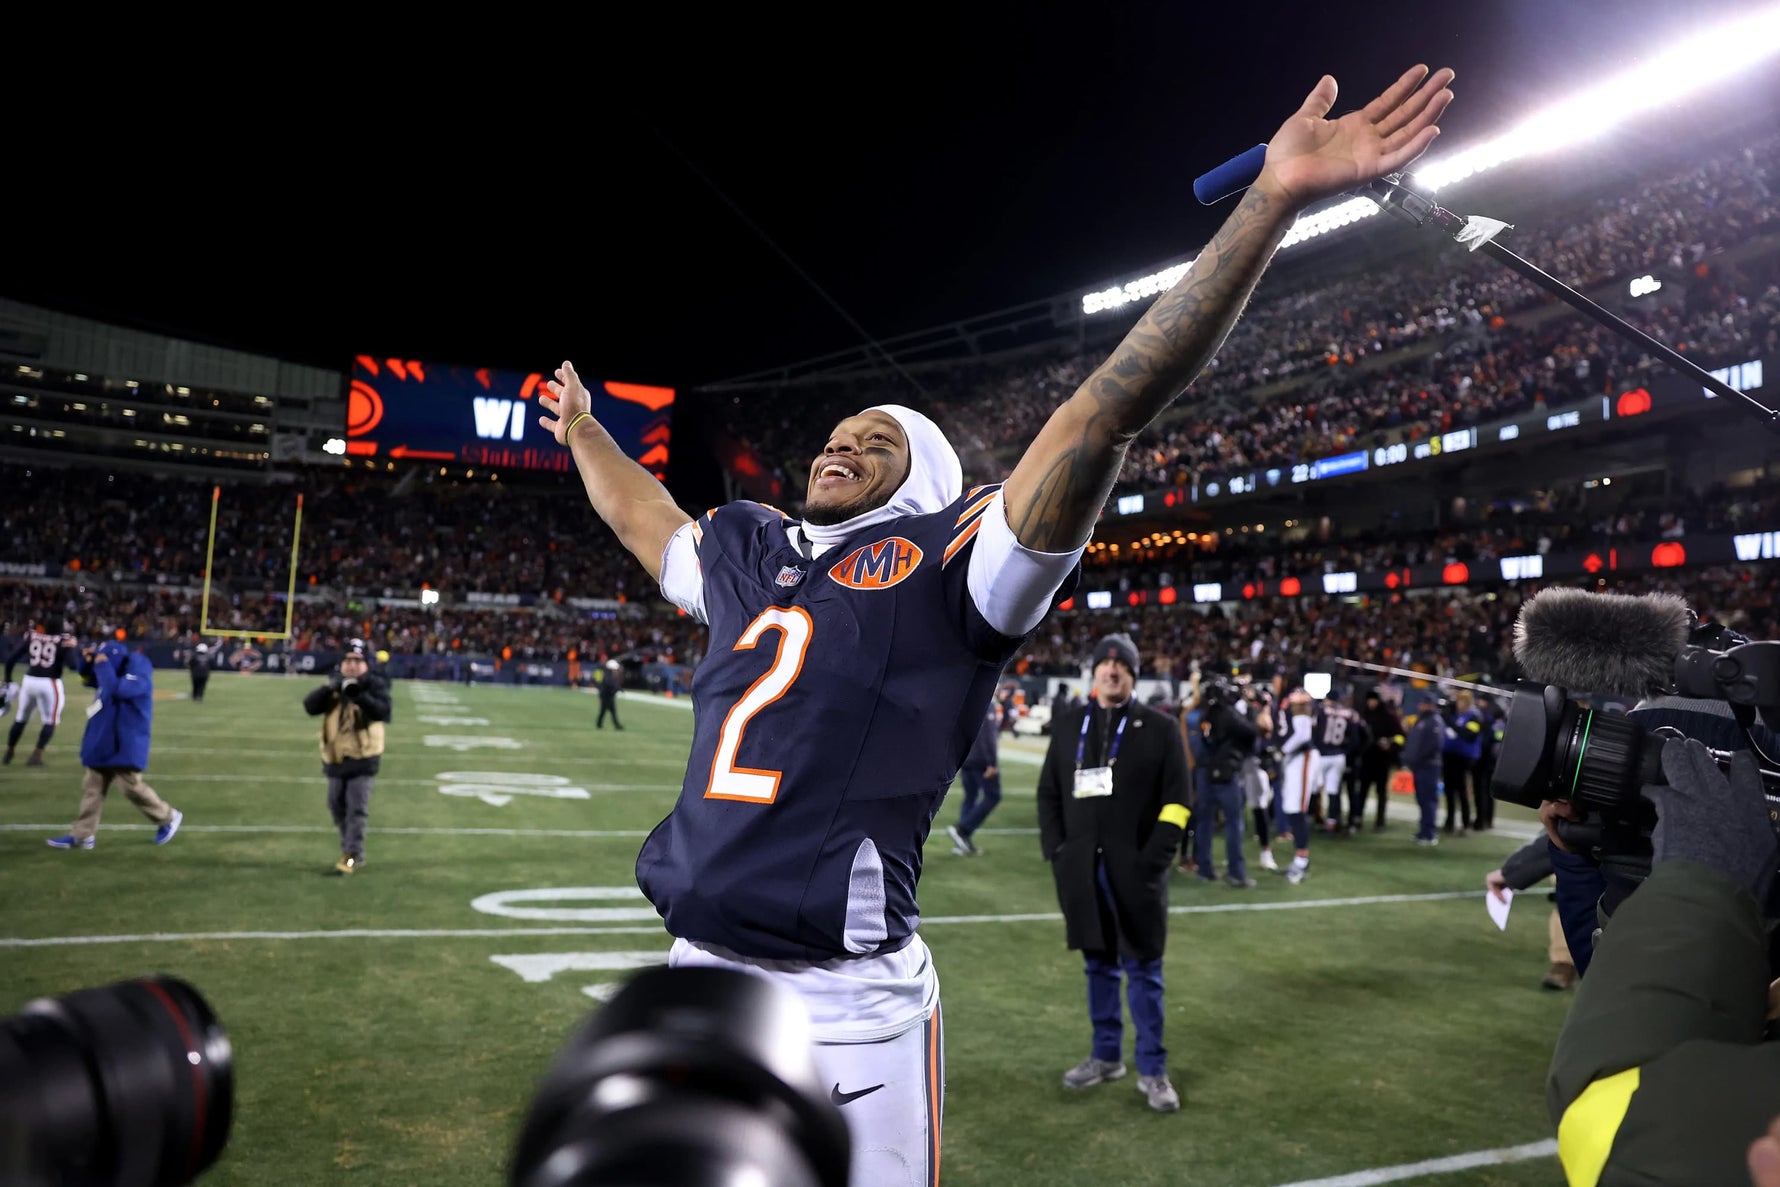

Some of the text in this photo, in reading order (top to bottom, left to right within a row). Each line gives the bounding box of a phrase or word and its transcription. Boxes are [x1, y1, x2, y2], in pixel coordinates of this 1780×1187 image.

[473, 397, 526, 441] WI
[1733, 531, 1780, 561] WI
[780, 573, 798, 584] NFL
[1500, 555, 1543, 580] WIN
[29, 641, 57, 668] 99
[704, 605, 814, 805] 2
[1323, 716, 1348, 746] 18
